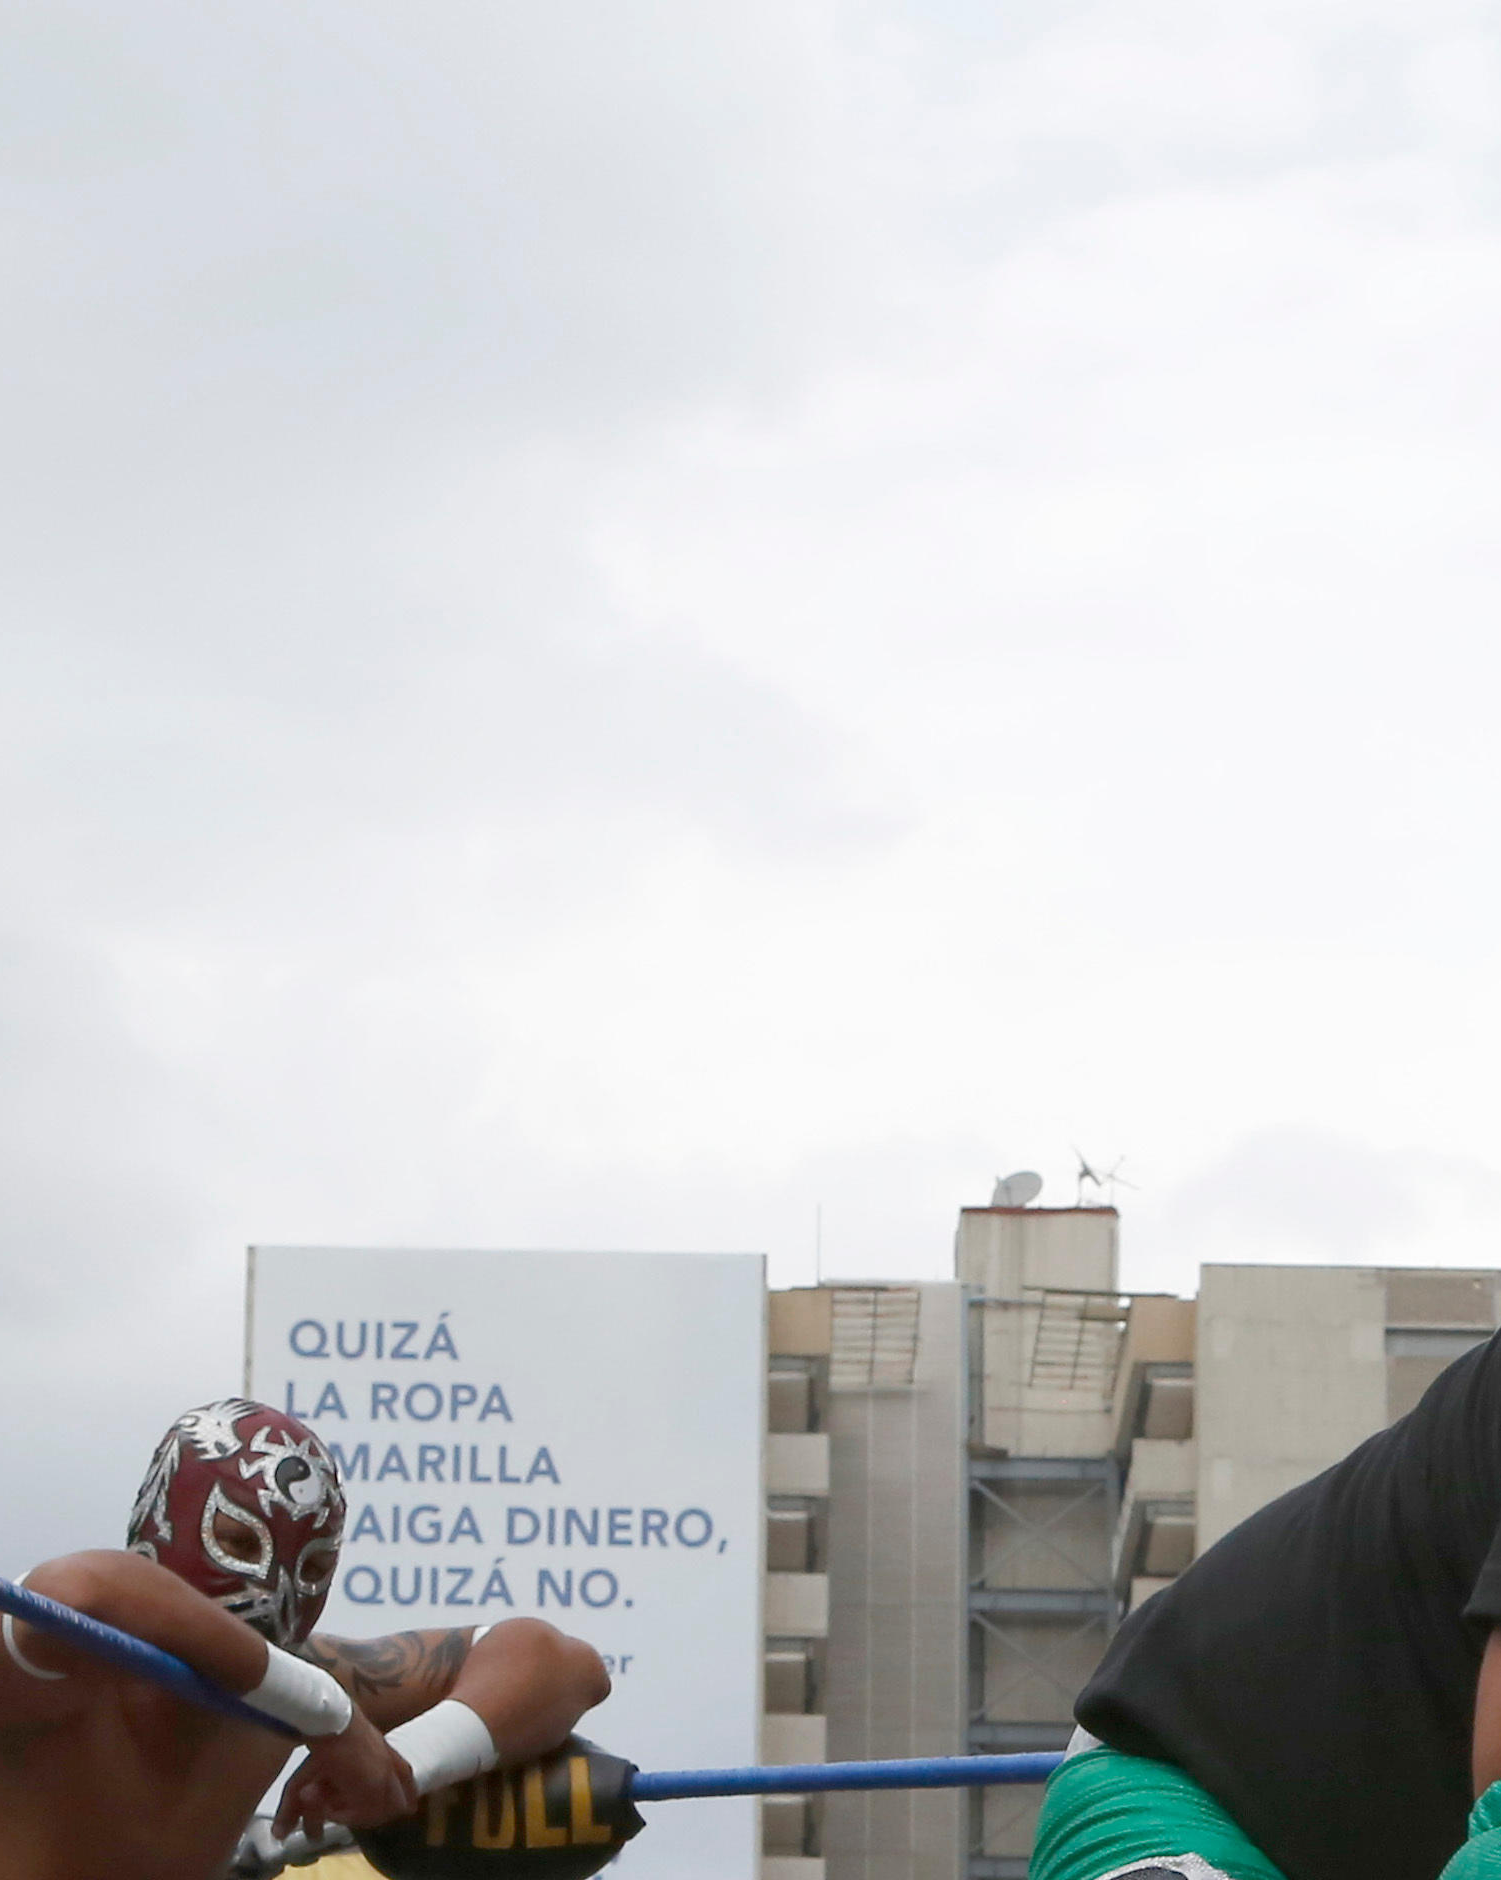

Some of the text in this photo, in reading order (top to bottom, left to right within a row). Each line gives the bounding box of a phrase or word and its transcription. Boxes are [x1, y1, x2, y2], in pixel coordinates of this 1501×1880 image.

[288, 1311, 460, 1361] QUIZÁ
[284, 1381, 514, 1423] LA ROPA
[331, 1442, 562, 1485] MARILLA
[349, 1503, 728, 1555] AIGA DINERO,
[342, 1556, 635, 1609] QUIZÁ NO.
